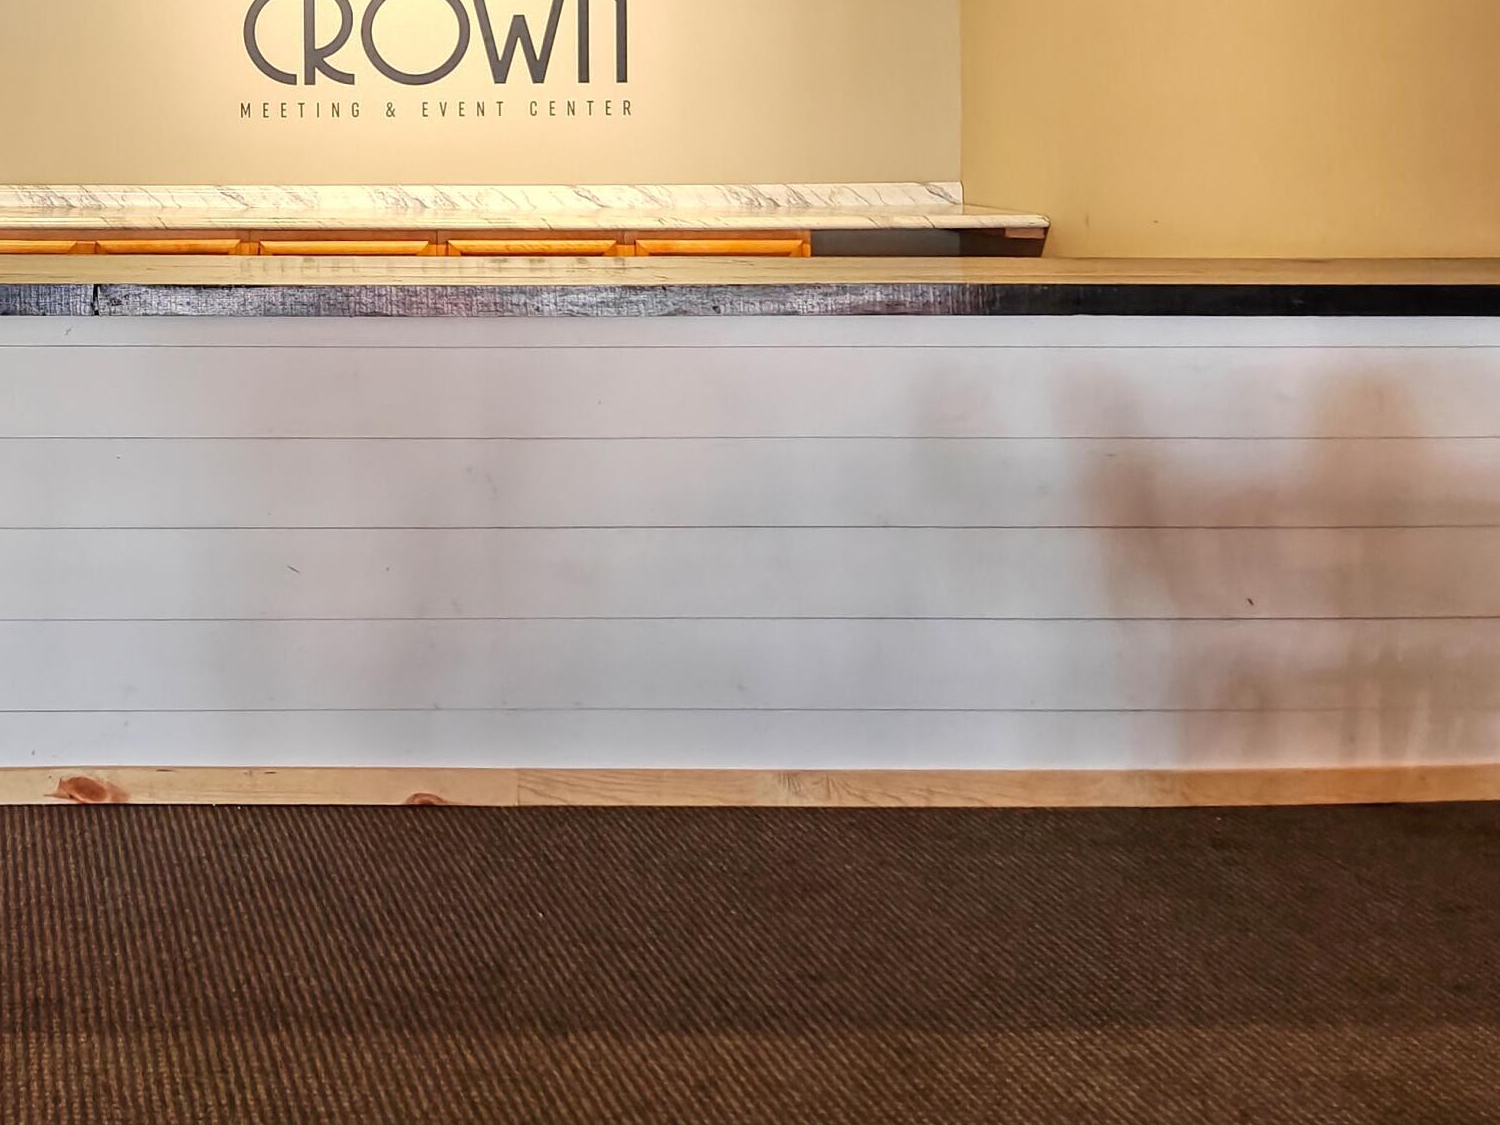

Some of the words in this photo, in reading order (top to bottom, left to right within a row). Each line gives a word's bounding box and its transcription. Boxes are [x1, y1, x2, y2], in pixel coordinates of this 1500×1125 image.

[240, 101, 362, 118] MEETING
[385, 101, 397, 118] &
[421, 101, 505, 117] EVENT
[529, 100, 632, 116] CENTER
